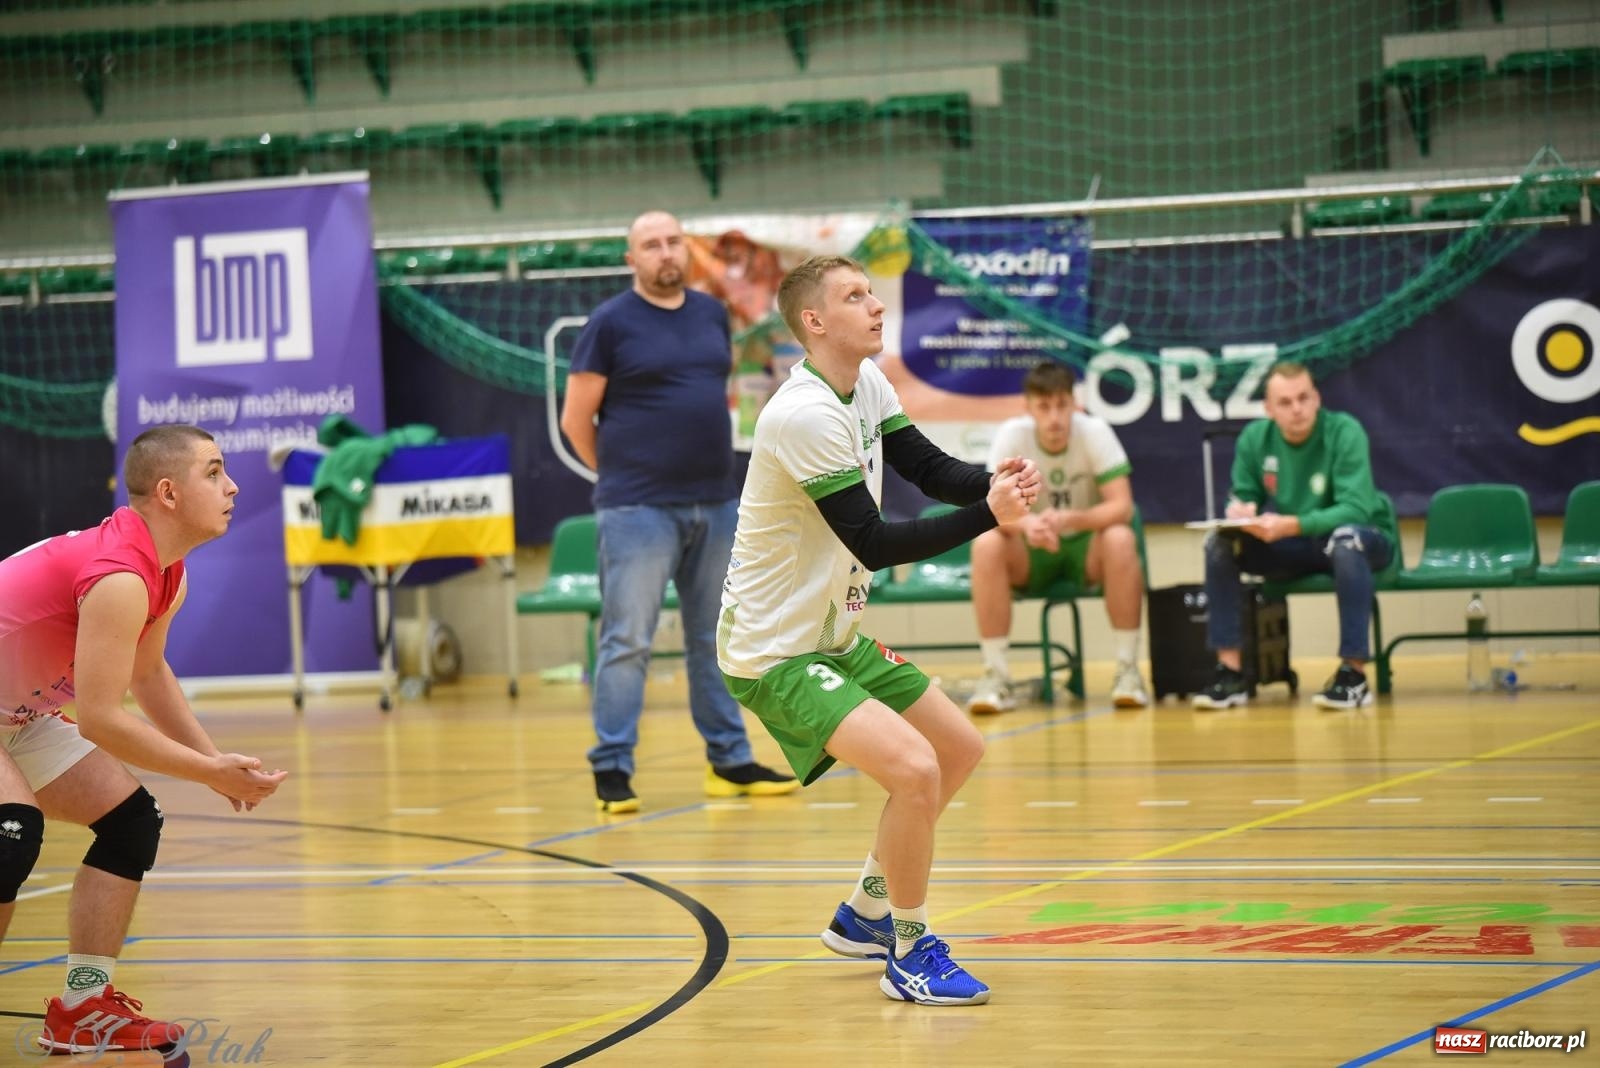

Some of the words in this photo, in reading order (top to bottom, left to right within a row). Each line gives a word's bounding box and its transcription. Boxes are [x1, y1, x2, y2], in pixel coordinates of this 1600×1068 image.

[189, 232, 294, 362] bmp
[1080, 323, 1279, 426] ÓRZ
[137, 392, 240, 426] budujemy
[241, 384, 355, 417] możliwości
[211, 421, 319, 454] ozumienia
[806, 663, 845, 692] 3
